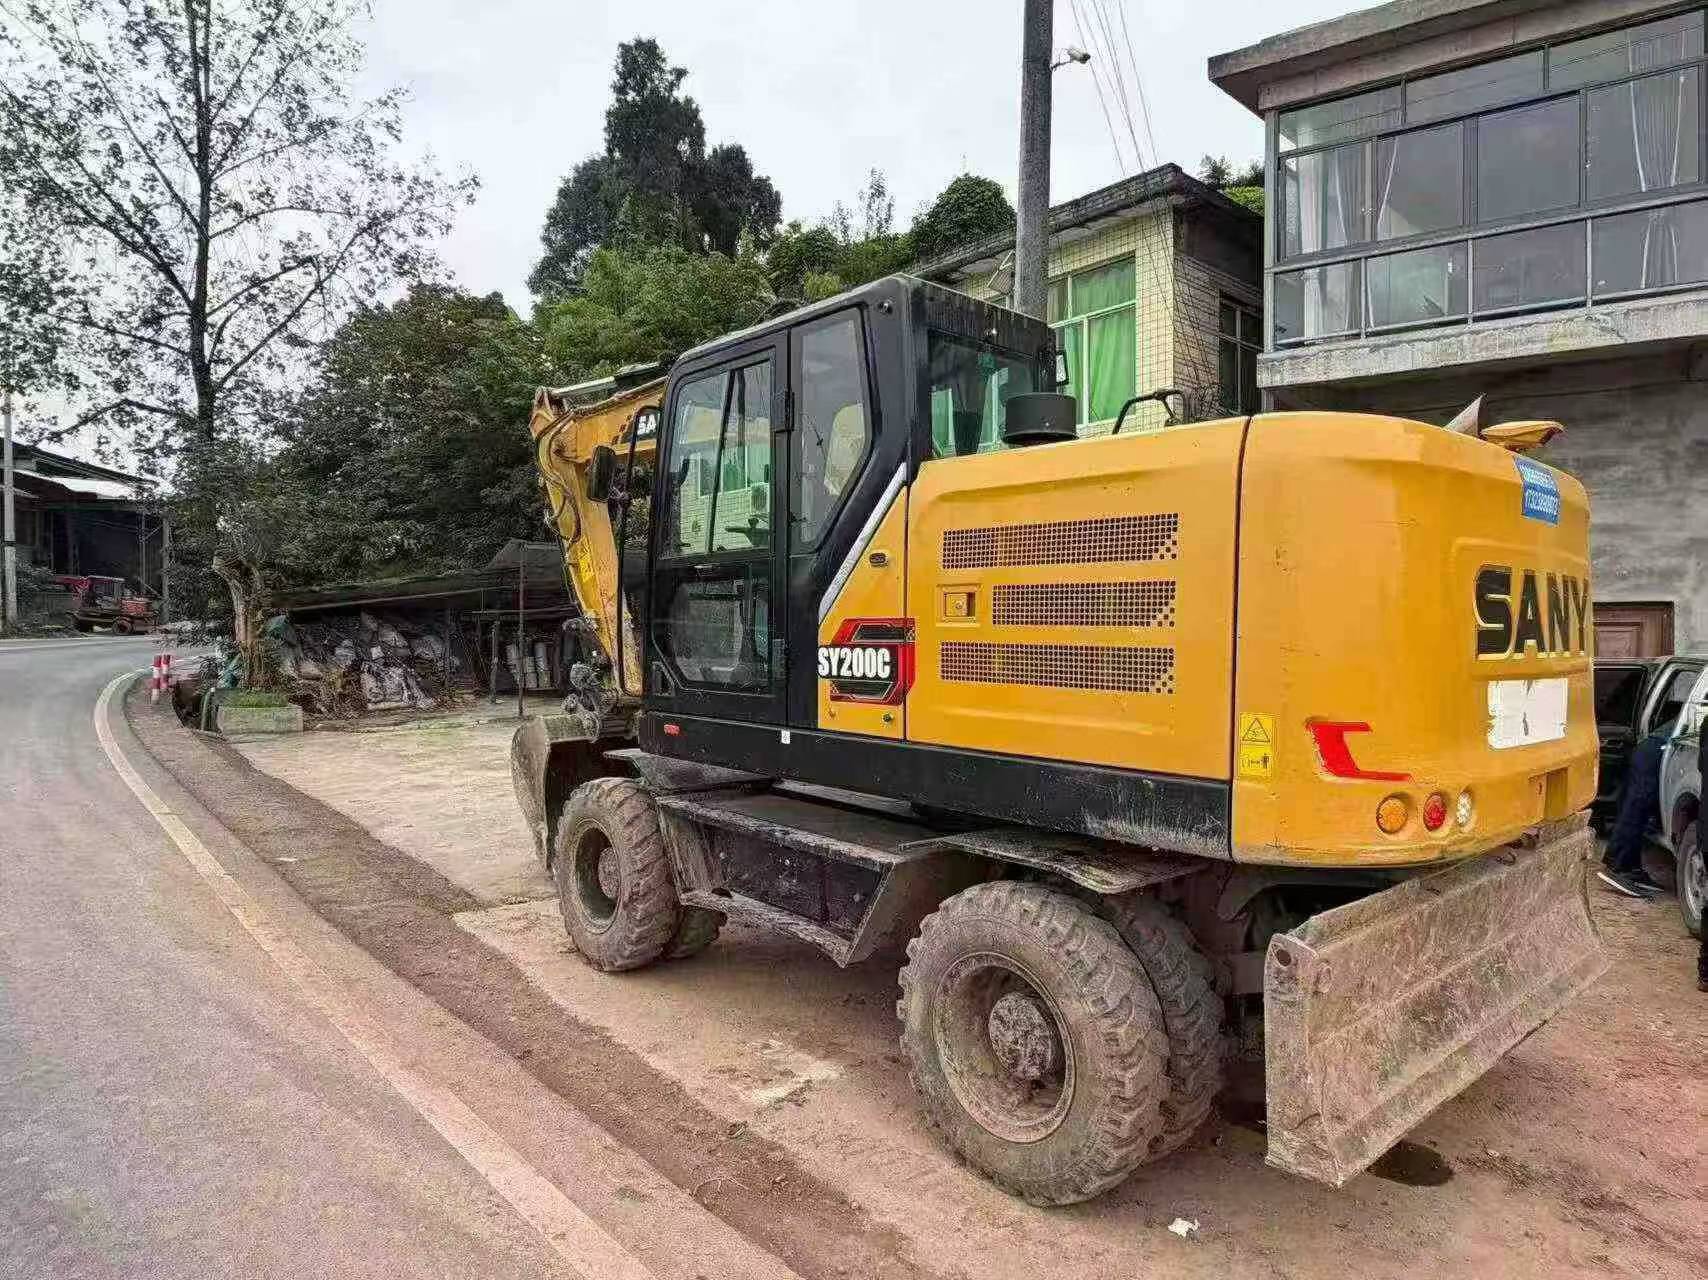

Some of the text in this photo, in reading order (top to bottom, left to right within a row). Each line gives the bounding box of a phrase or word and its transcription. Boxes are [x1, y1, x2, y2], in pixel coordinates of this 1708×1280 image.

[637, 413, 660, 435] SA
[1474, 564, 1589, 658] SANY
[817, 646, 891, 679] SY200C
